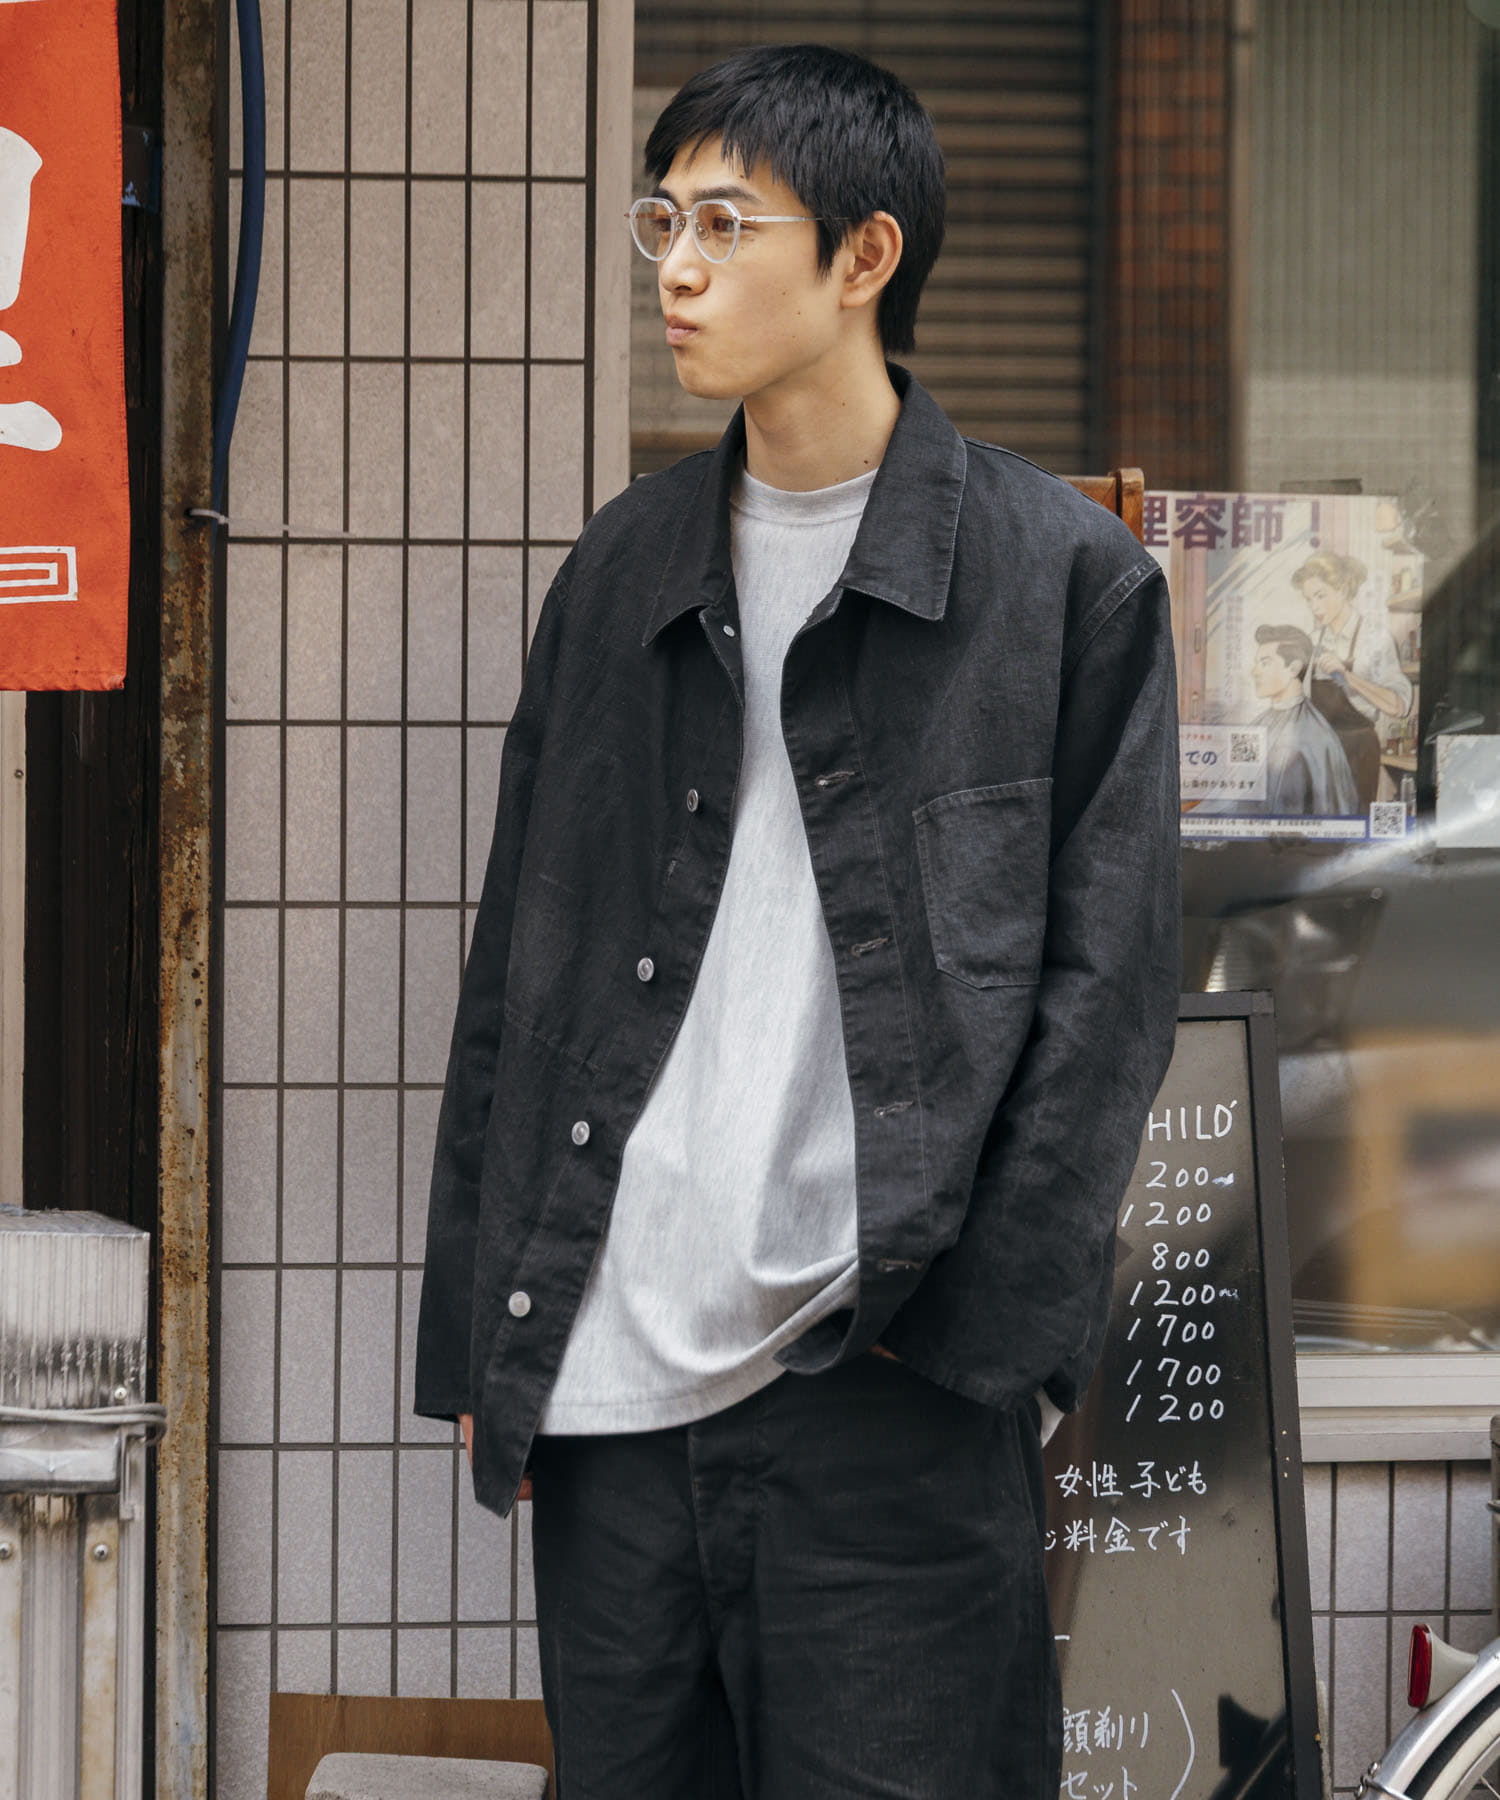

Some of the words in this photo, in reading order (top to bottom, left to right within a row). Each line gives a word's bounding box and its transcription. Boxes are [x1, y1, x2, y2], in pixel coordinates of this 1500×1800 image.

[1120, 1201, 1213, 1228] 1200
[1150, 1242, 1211, 1271] 800
[1129, 1279, 1217, 1306] 1200
[1127, 1314, 1216, 1347] 1700
[1126, 1357, 1222, 1388] 1700
[1125, 1394, 1225, 1422] 1200
